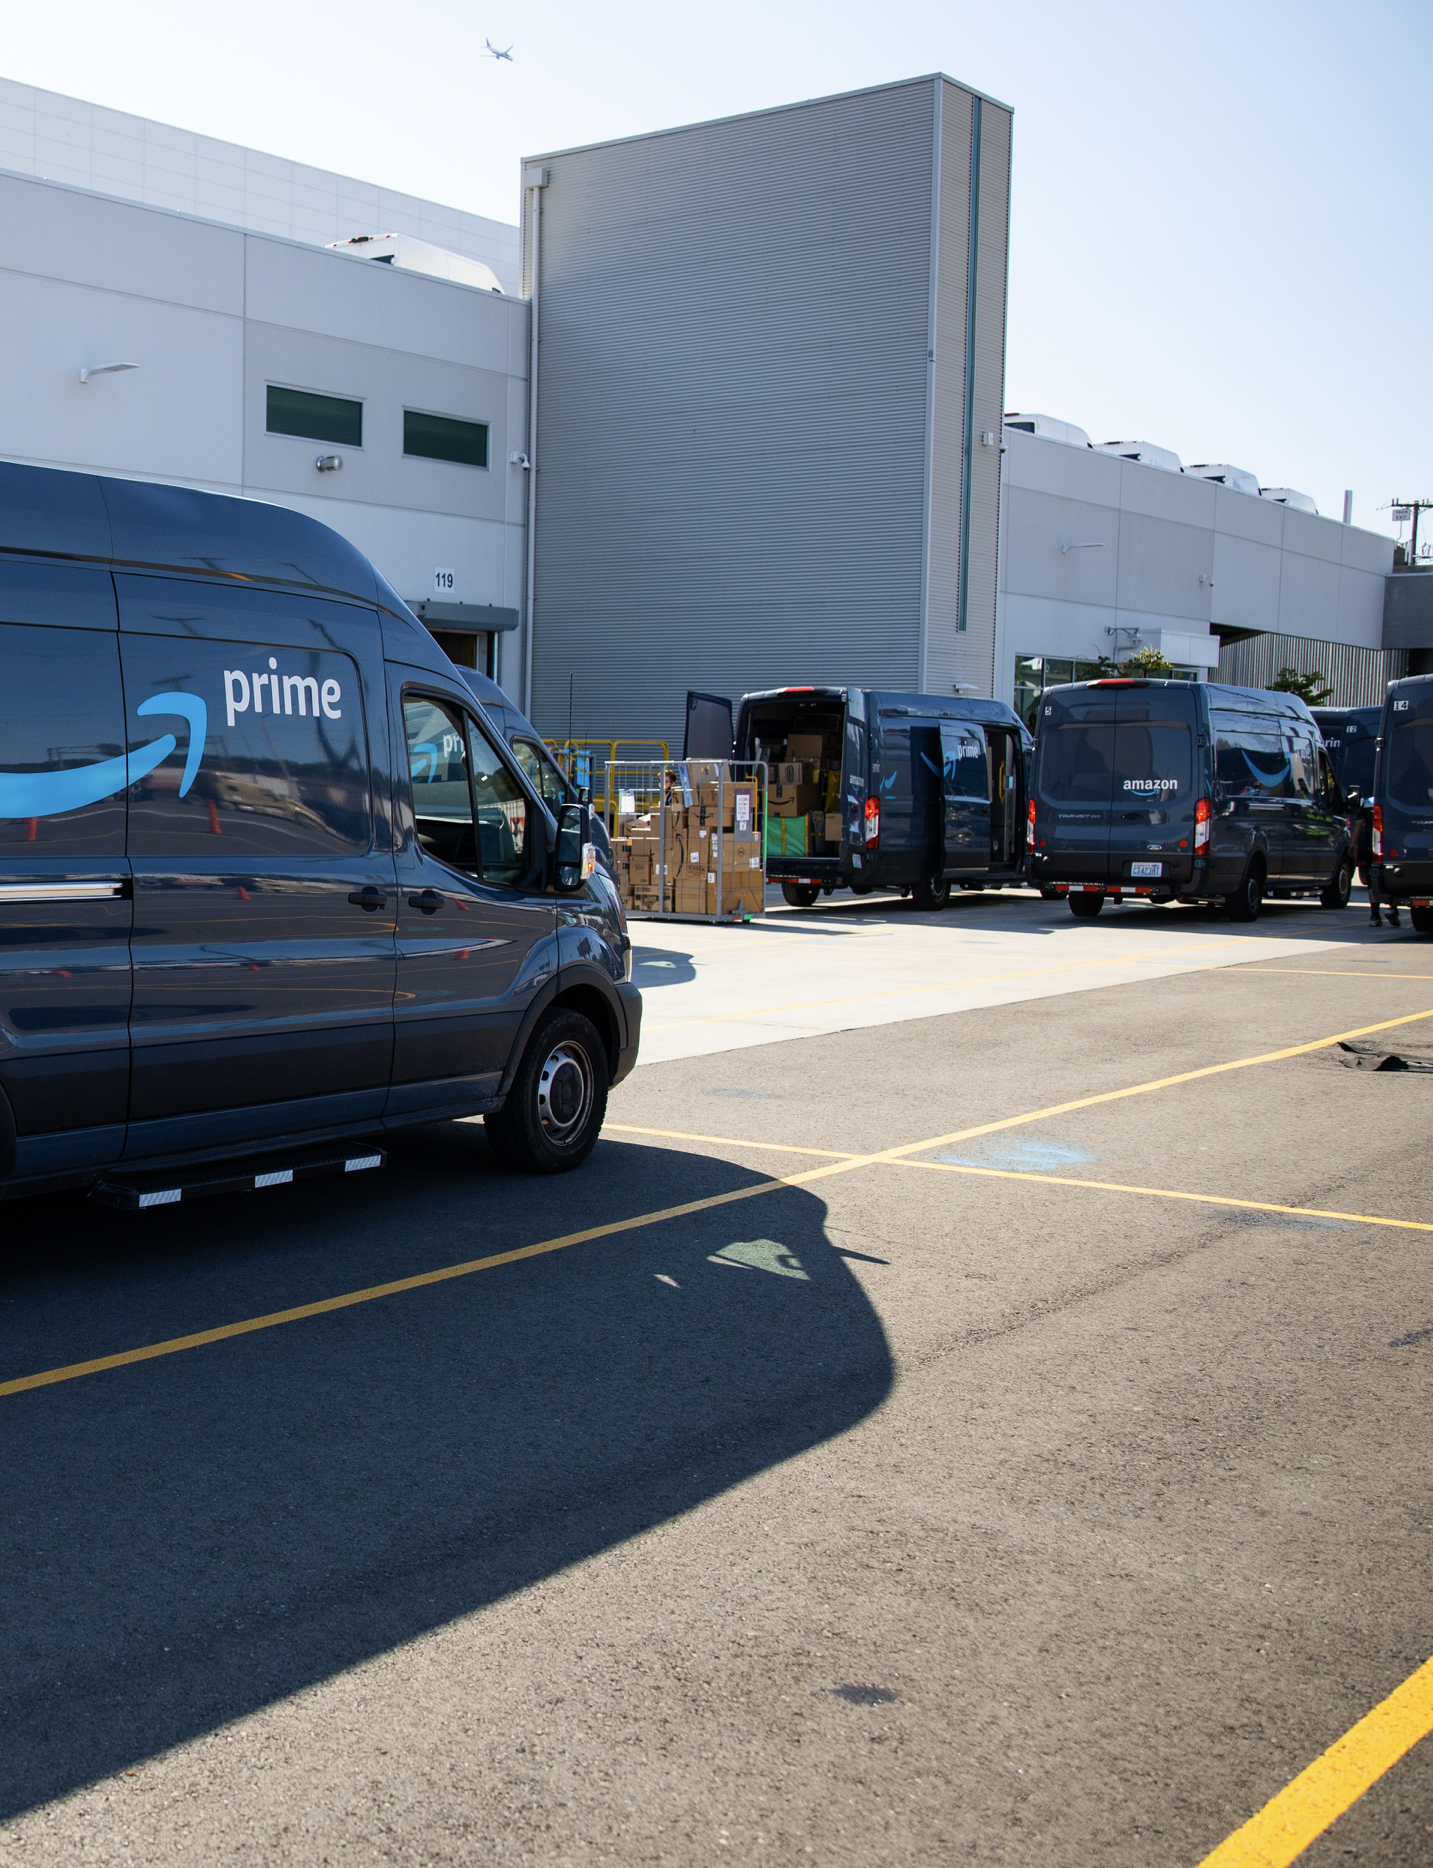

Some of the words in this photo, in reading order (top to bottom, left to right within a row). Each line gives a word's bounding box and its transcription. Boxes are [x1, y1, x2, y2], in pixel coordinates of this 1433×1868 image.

[435, 572, 454, 588] 119
[223, 656, 342, 727] prime
[1046, 706, 1051, 715] 5
[443, 734, 465, 757] pri
[957, 740, 979, 761] prime
[1123, 779, 1178, 790] amazon
